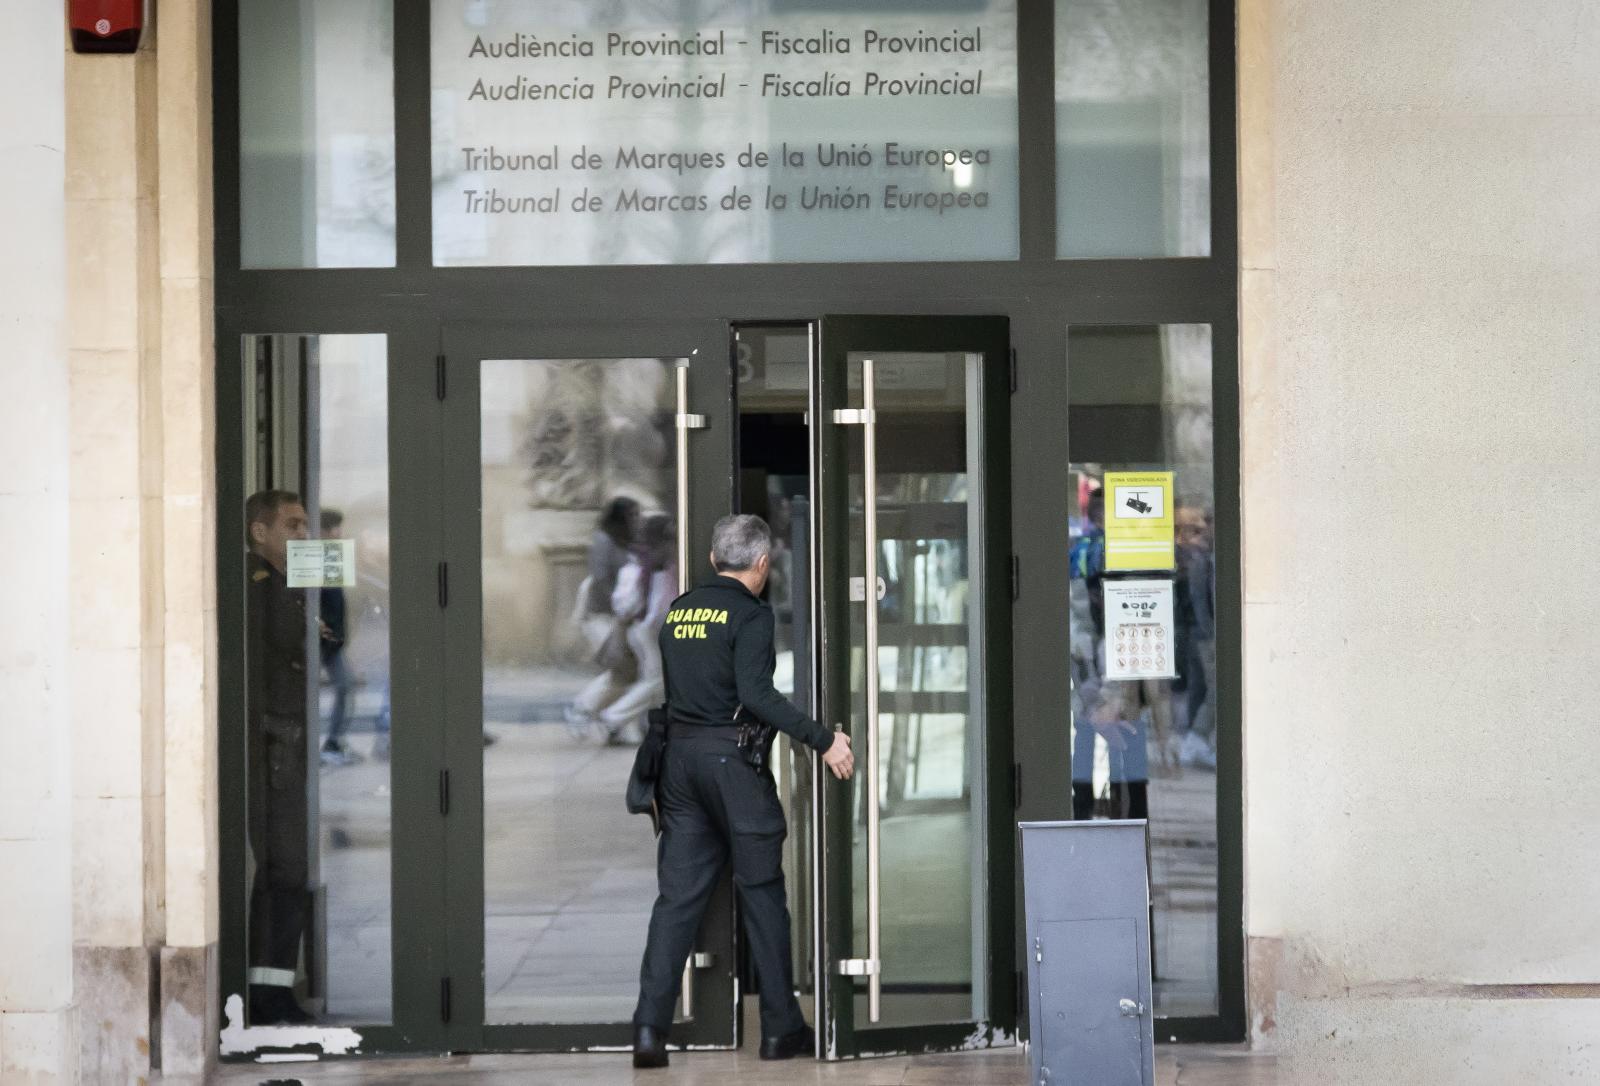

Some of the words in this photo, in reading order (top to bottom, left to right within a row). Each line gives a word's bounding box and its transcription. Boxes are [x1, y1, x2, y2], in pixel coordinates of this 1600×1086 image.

[468, 32, 594, 58] Audiència
[607, 30, 725, 56] Provincial
[761, 29, 850, 54] Fiscalia
[864, 27, 981, 53] Provincial
[468, 75, 594, 101] Audiencia
[607, 73, 726, 99] Provincial
[761, 71, 850, 97] Fiscalía
[864, 69, 982, 96] Provincial
[461, 145, 559, 171] Tribunal
[571, 145, 602, 170] de
[615, 146, 725, 176] Marques
[737, 142, 769, 168] de
[782, 142, 804, 168] la
[817, 142, 872, 168] Unió
[885, 142, 990, 172] Europea
[463, 187, 560, 213] Tribunal
[571, 187, 602, 213] de
[615, 188, 708, 212] Marcas
[720, 185, 752, 211] de
[765, 185, 787, 210] la
[800, 185, 871, 210] Unión
[883, 184, 989, 215] Europea
[665, 608, 729, 625] GUARDIA
[673, 624, 707, 639] CIVIL
